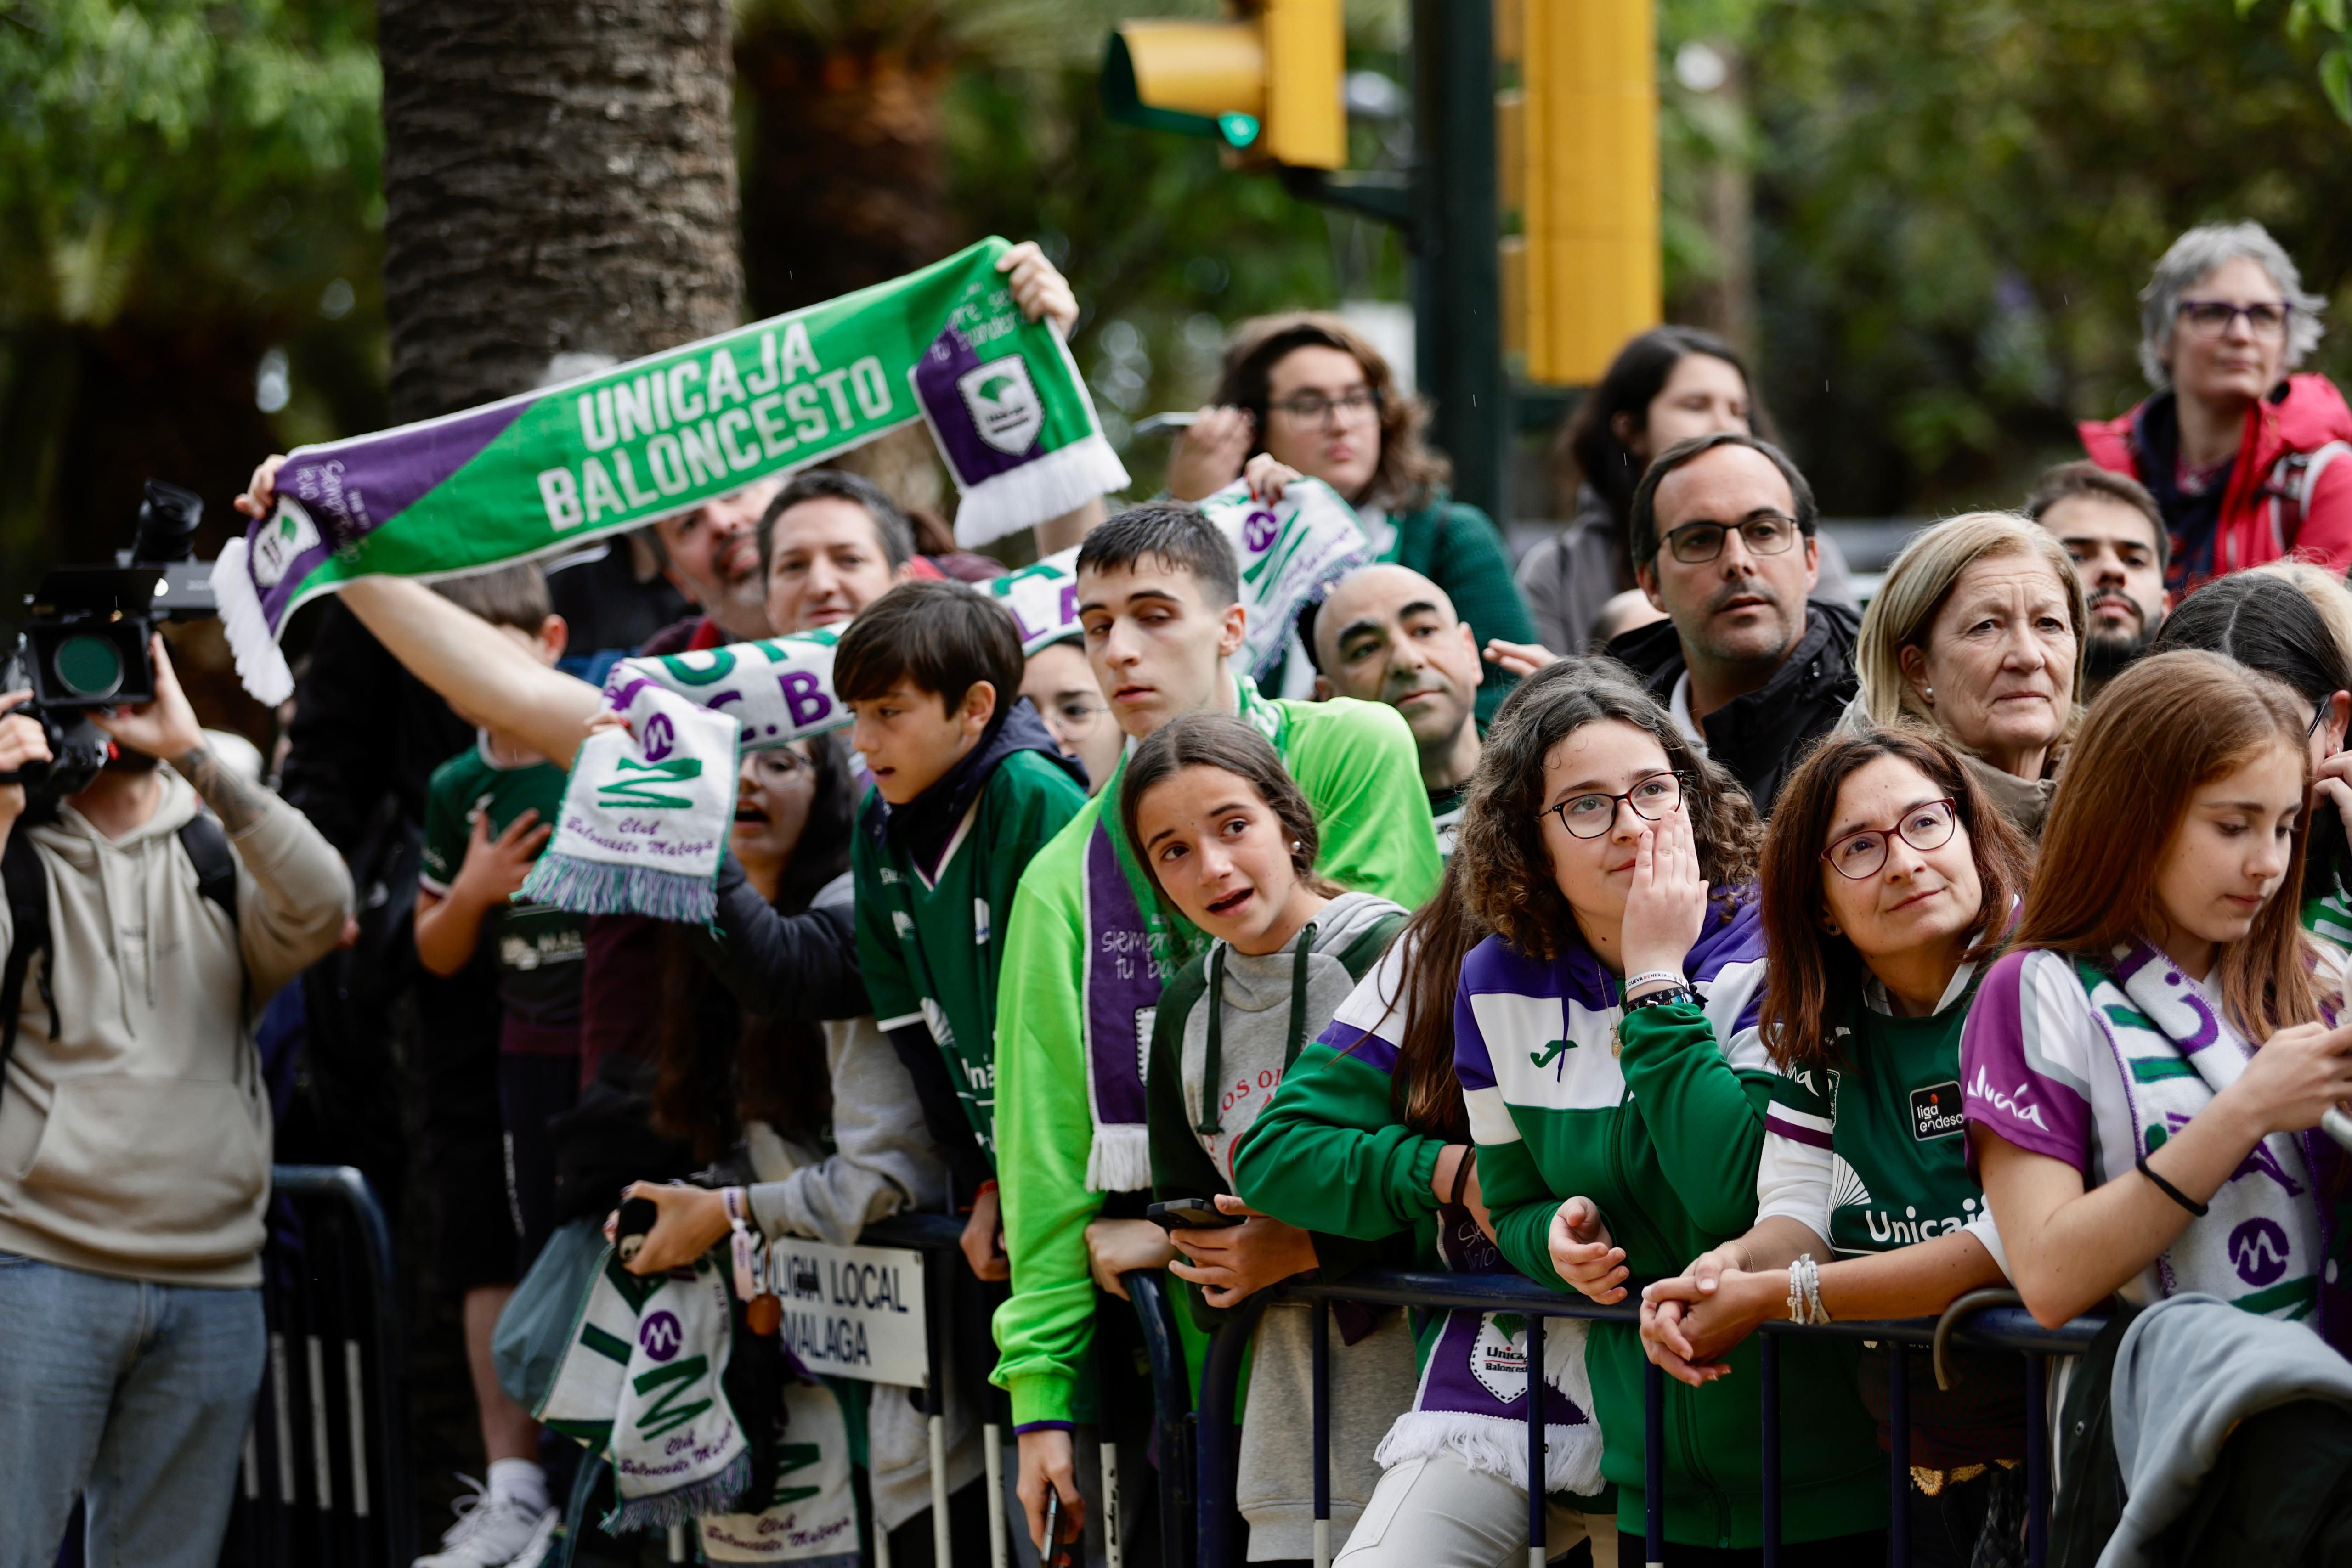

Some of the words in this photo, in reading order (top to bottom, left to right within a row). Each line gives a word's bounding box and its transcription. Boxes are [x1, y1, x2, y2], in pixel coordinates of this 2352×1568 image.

[577, 321, 822, 453] UNICAJA
[537, 355, 893, 532] BALONCESTO
[1101, 927, 1167, 962] siempr
[1917, 1105, 1939, 1120] liga
[1919, 1113, 1963, 1132] endesa
[830, 1259, 909, 1314] LOCAL
[1485, 1363, 1528, 1373] Baloncest
